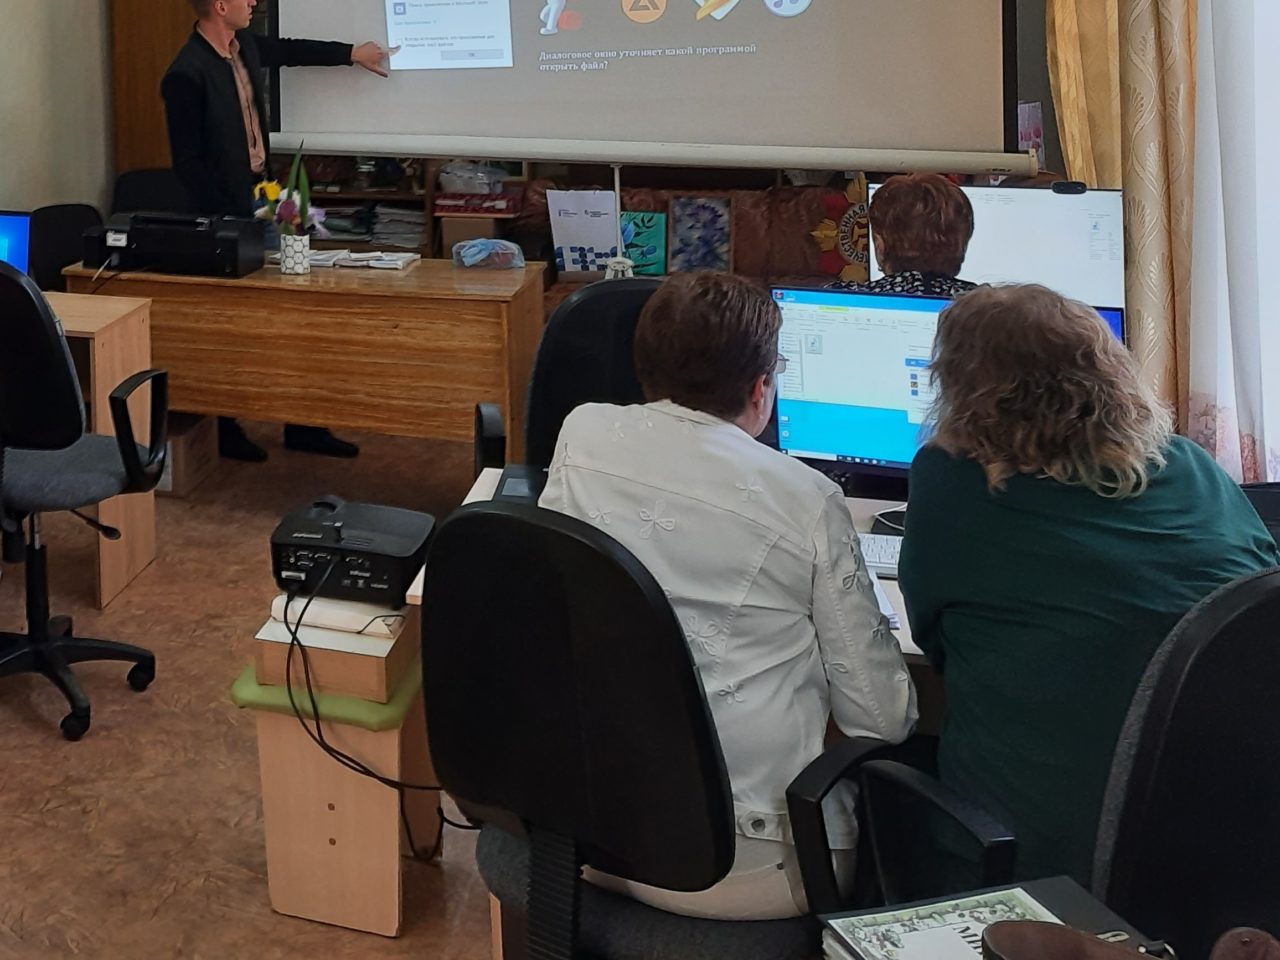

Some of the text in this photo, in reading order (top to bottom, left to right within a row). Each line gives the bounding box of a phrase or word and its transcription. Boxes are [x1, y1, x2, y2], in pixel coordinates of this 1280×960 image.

[539, 43, 757, 61] Диалоговое окно уточняет какой программой
[539, 60, 608, 72] открыть файл?
